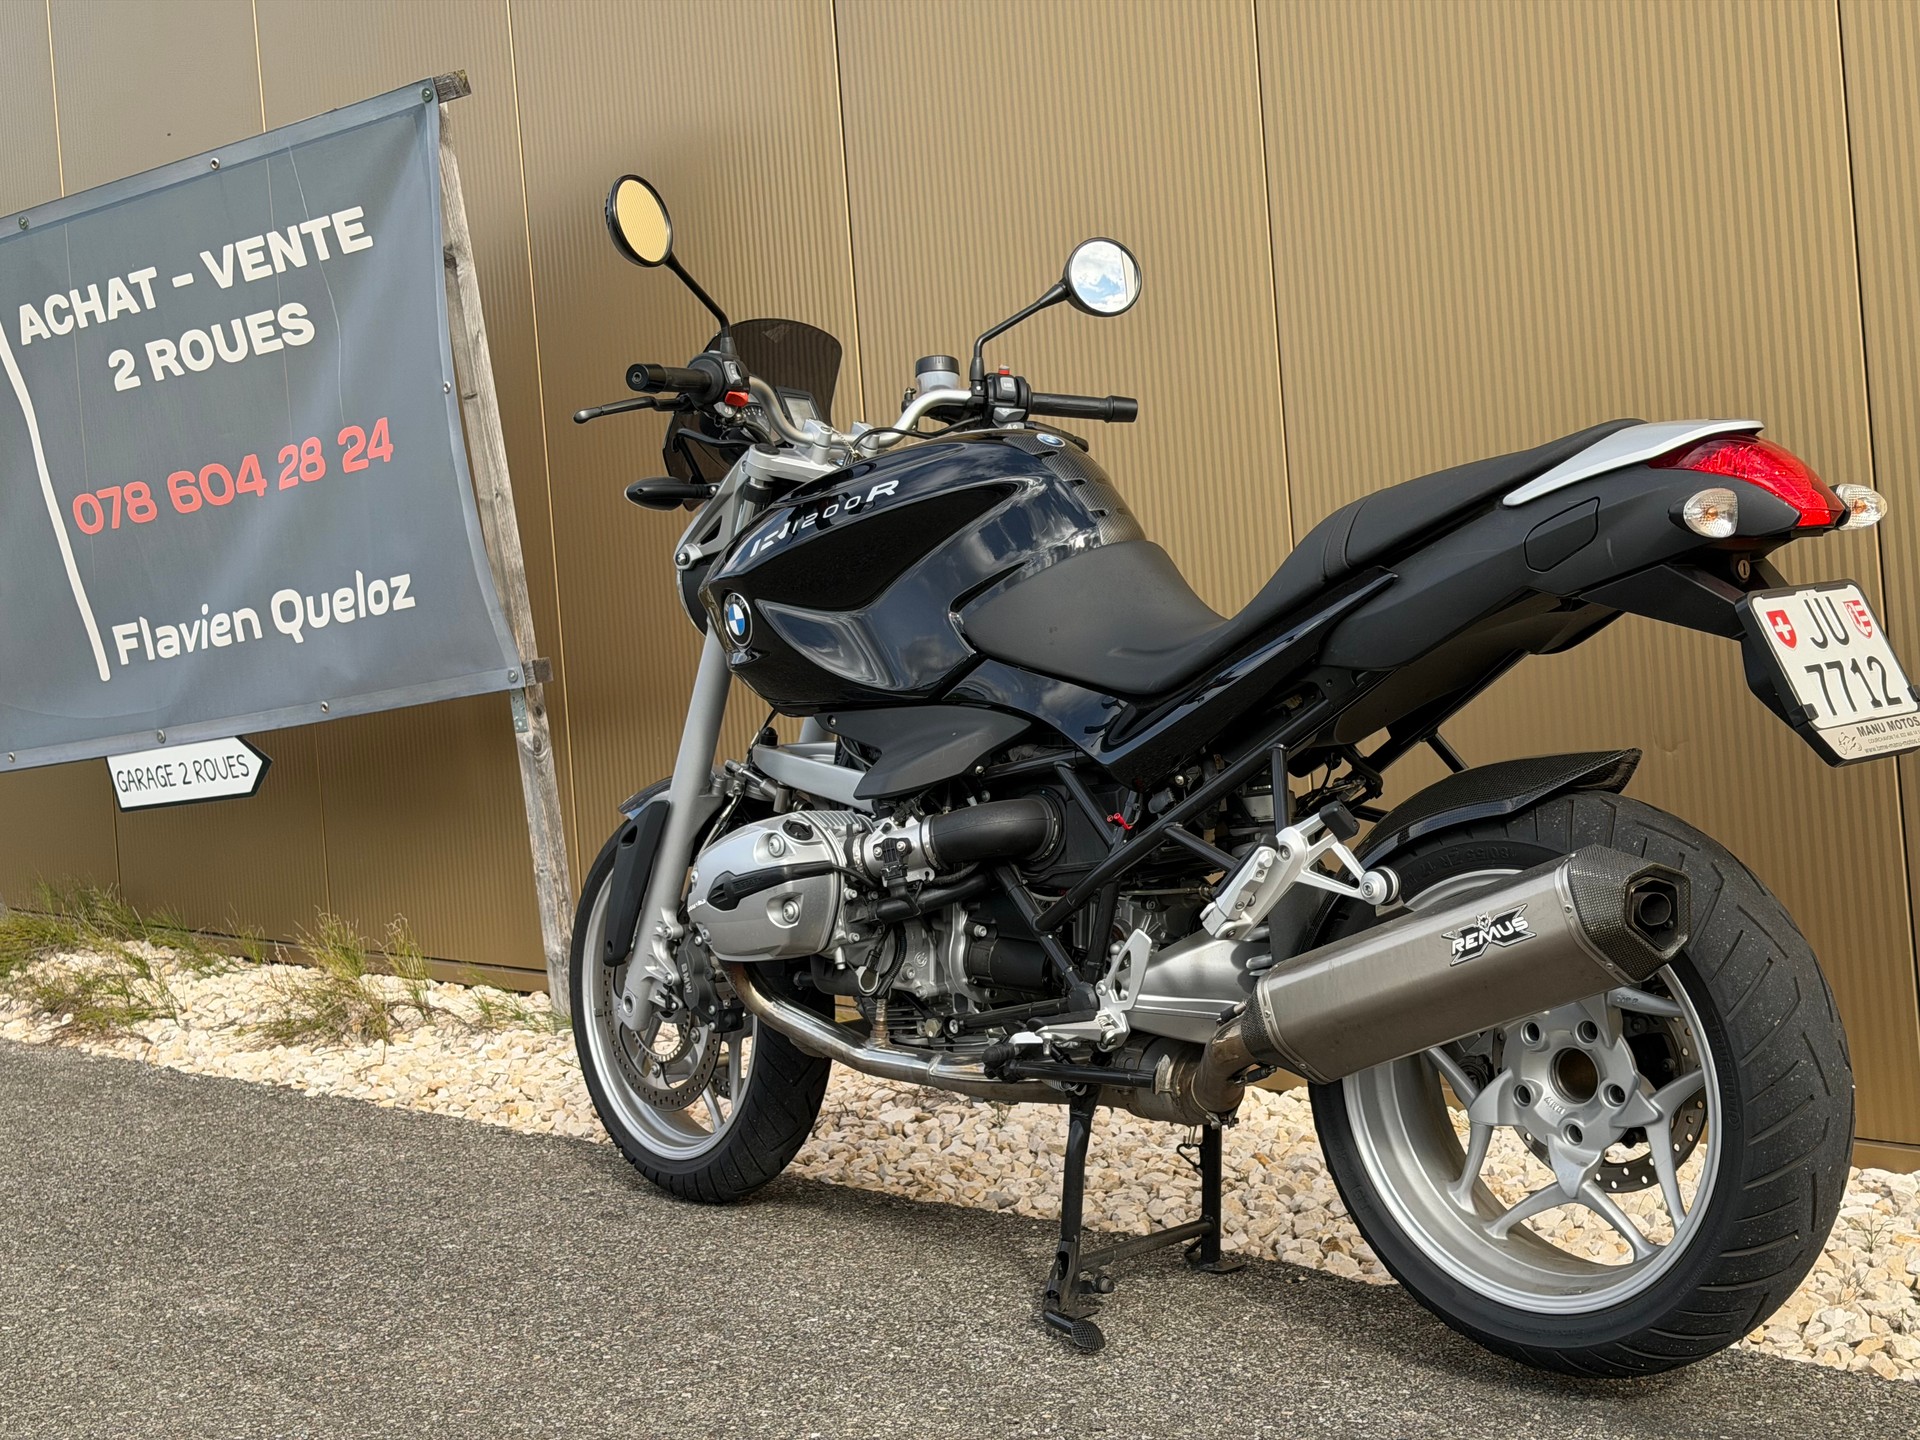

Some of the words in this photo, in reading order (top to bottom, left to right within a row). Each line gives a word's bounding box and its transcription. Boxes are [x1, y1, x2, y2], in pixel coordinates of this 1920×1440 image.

[18, 266, 158, 346] ACHAT
[172, 272, 194, 288] -
[199, 205, 374, 289] VENTE
[107, 349, 141, 392] 2
[144, 302, 316, 382] ROUES
[72, 481, 158, 535] 078
[166, 453, 268, 514] 604
[277, 436, 327, 491] 28
[337, 416, 394, 474] 24
[111, 603, 263, 666] Flavien
[270, 569, 416, 643] Queloz
[1803, 596, 1850, 650] JU
[1803, 655, 1903, 716] 7712
[1856, 722, 1887, 738] MANU
[1886, 716, 1920, 732] MOTOS
[116, 763, 177, 793] GARAGE
[178, 761, 192, 785] 2
[192, 753, 250, 784] ROUES
[1451, 916, 1529, 955] REMUS
[681, 962, 693, 993] BMW
